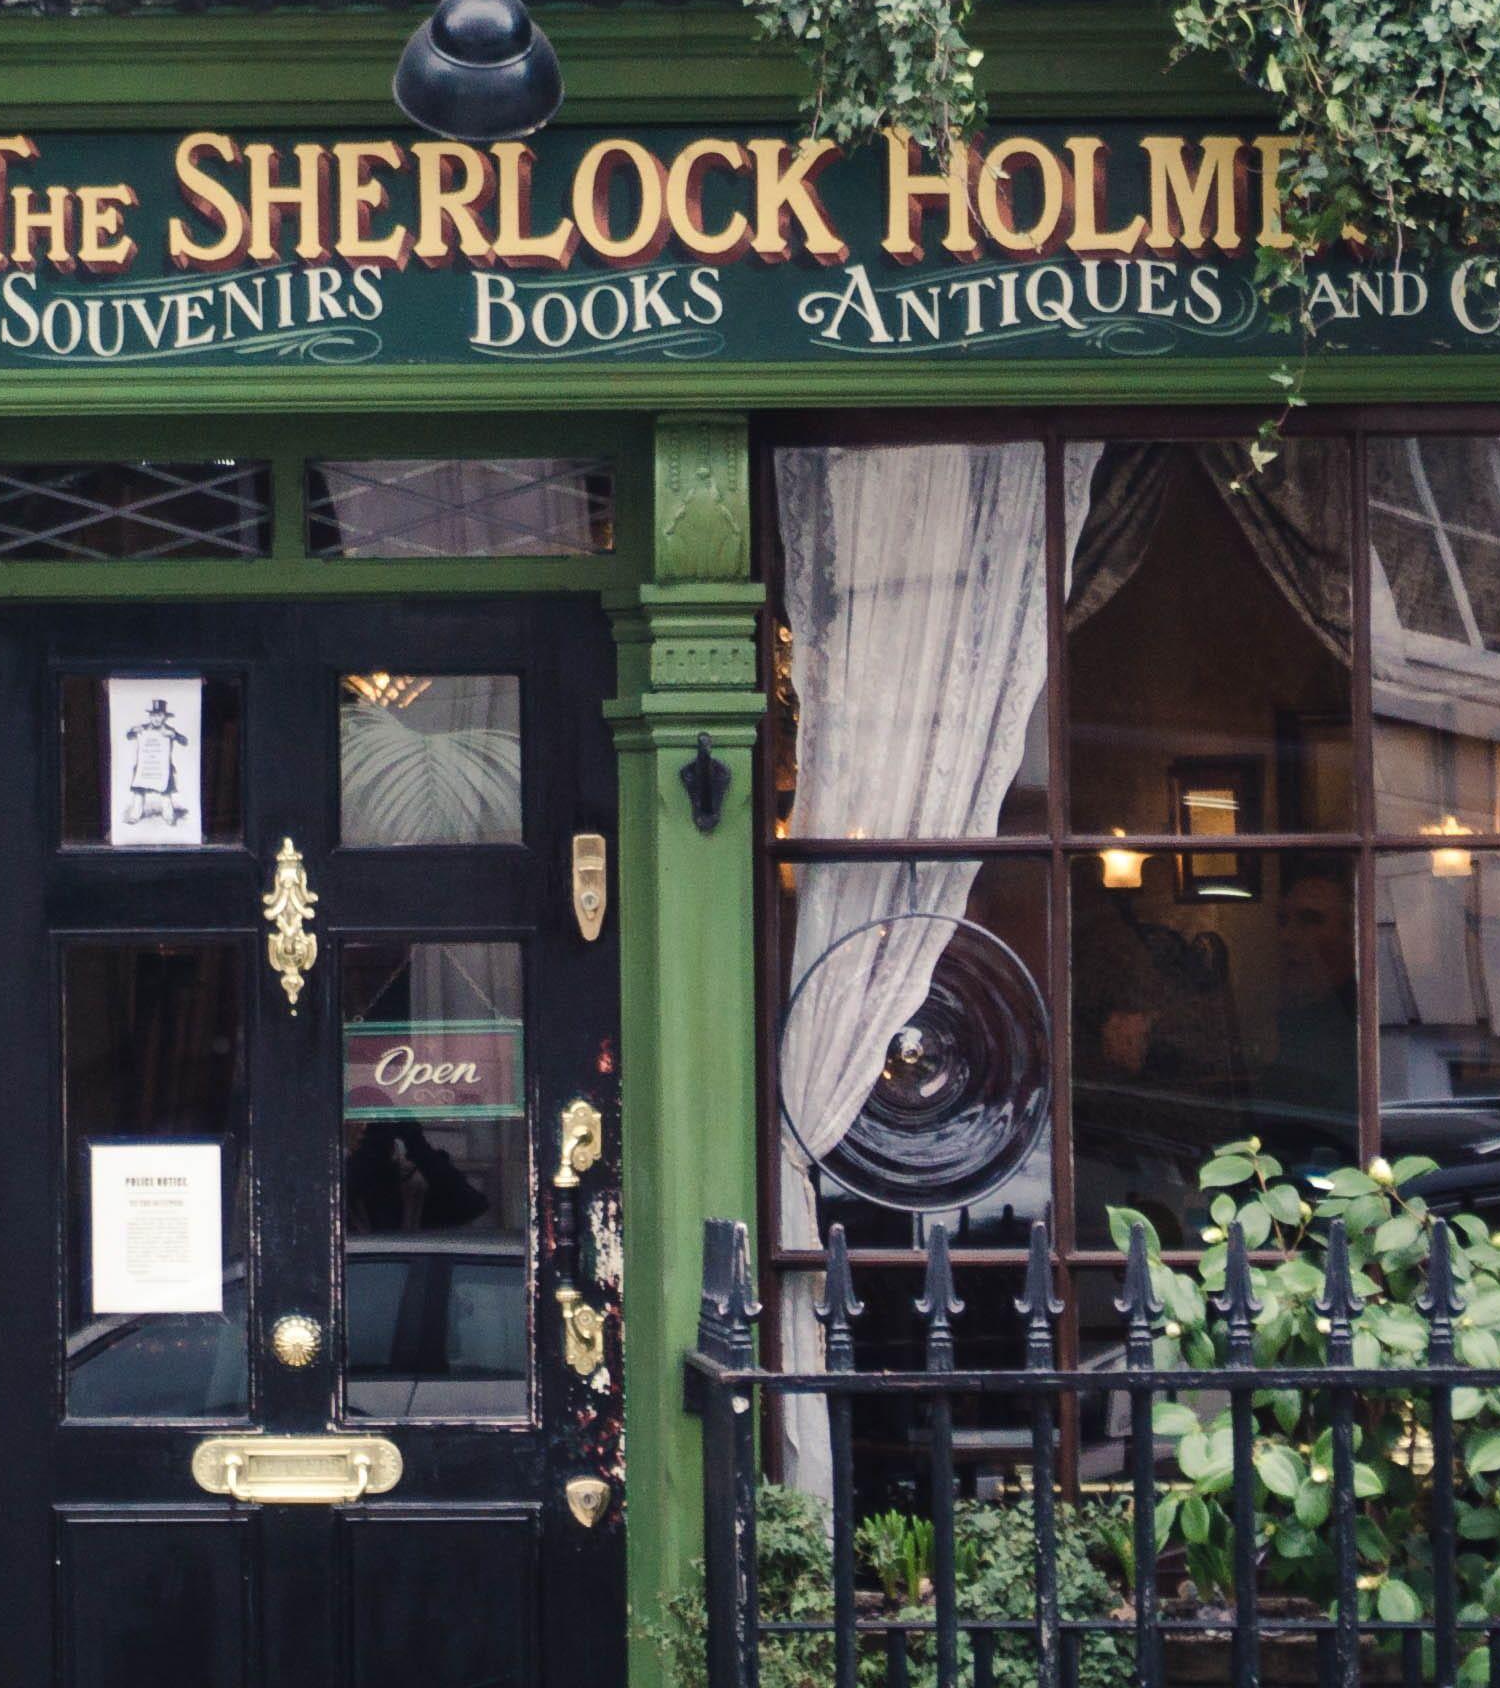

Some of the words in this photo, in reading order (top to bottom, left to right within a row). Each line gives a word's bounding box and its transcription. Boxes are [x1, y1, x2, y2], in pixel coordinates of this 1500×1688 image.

[168, 131, 851, 272] SHERLOCK
[880, 128, 1367, 267] HOLME
[0, 264, 383, 356] SOUVENIRS
[470, 266, 724, 348] BOOKS
[798, 260, 1223, 345] ANTIQUES
[1307, 270, 1428, 319] AND
[374, 1045, 482, 1095] Open
